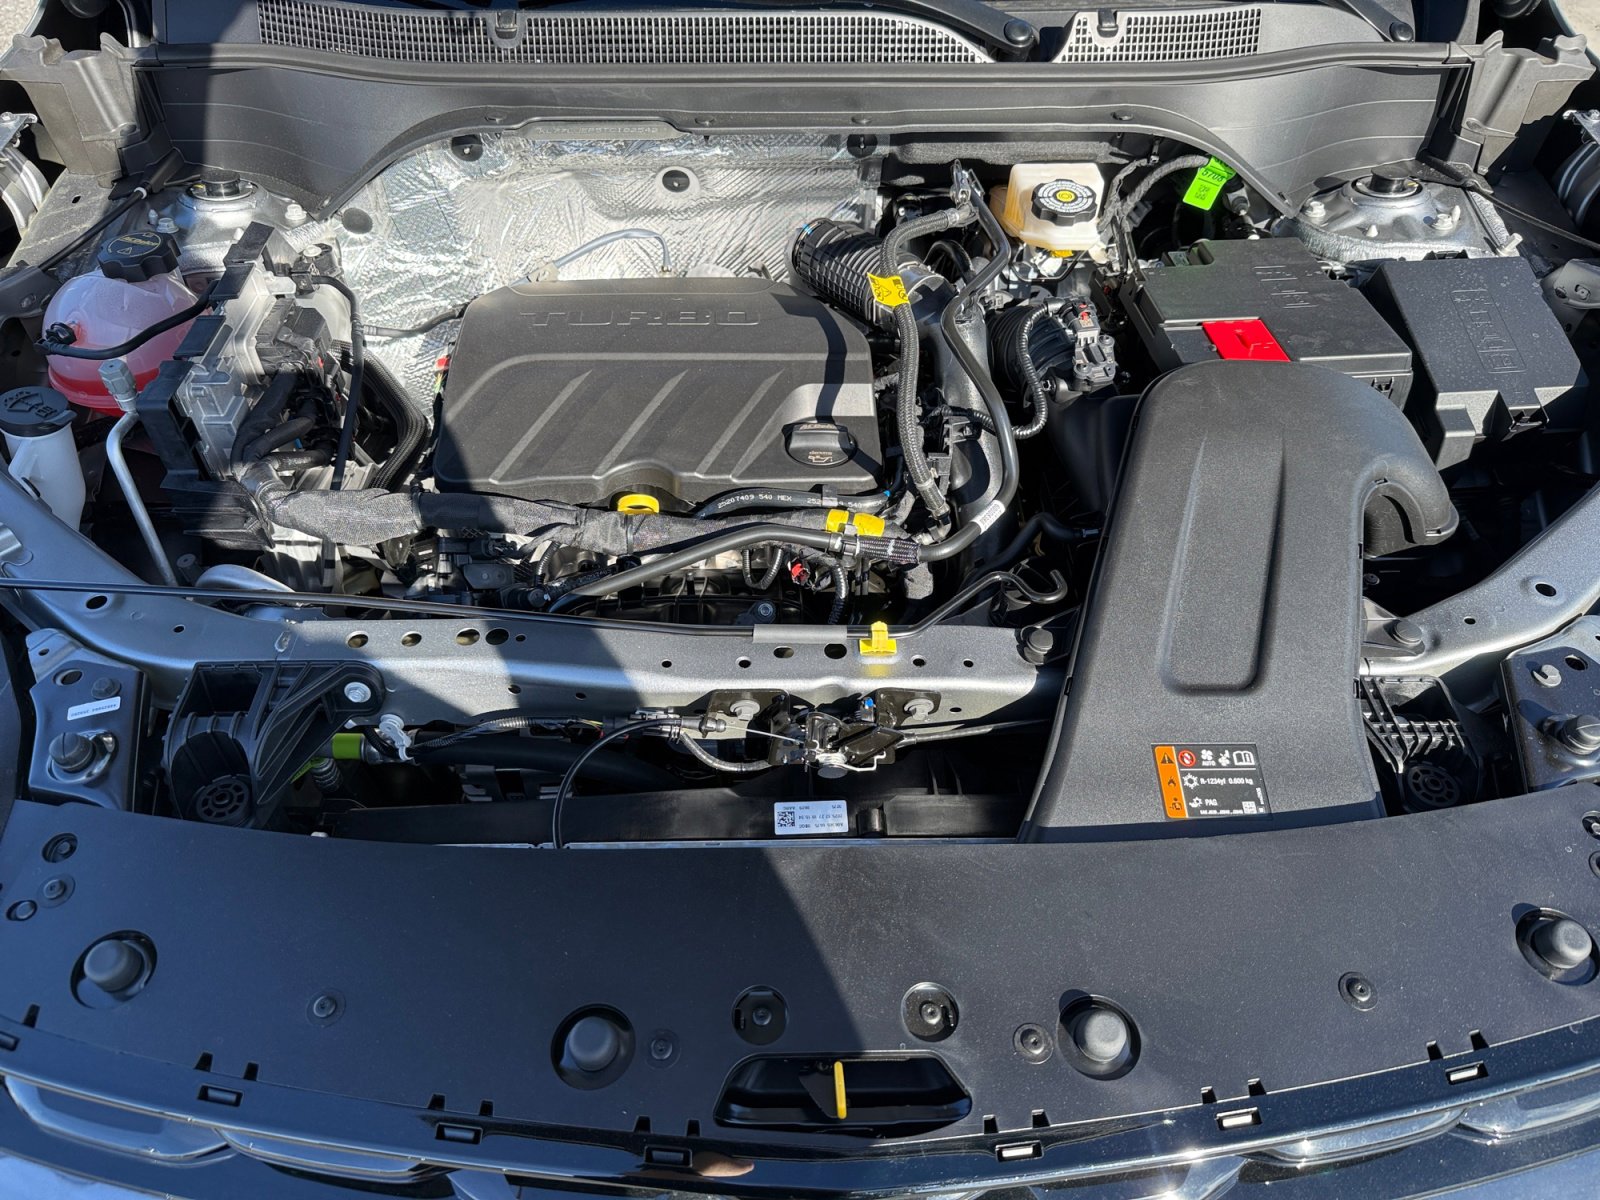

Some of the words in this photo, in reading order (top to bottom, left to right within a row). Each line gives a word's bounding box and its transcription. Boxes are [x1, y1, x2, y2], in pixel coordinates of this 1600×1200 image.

[519, 311, 760, 326] TURBO
[717, 494, 755, 509] 25207409
[777, 494, 793, 502] MEX
[1199, 777, 1226, 786] R-1234yf
[1245, 777, 1253, 786] kg
